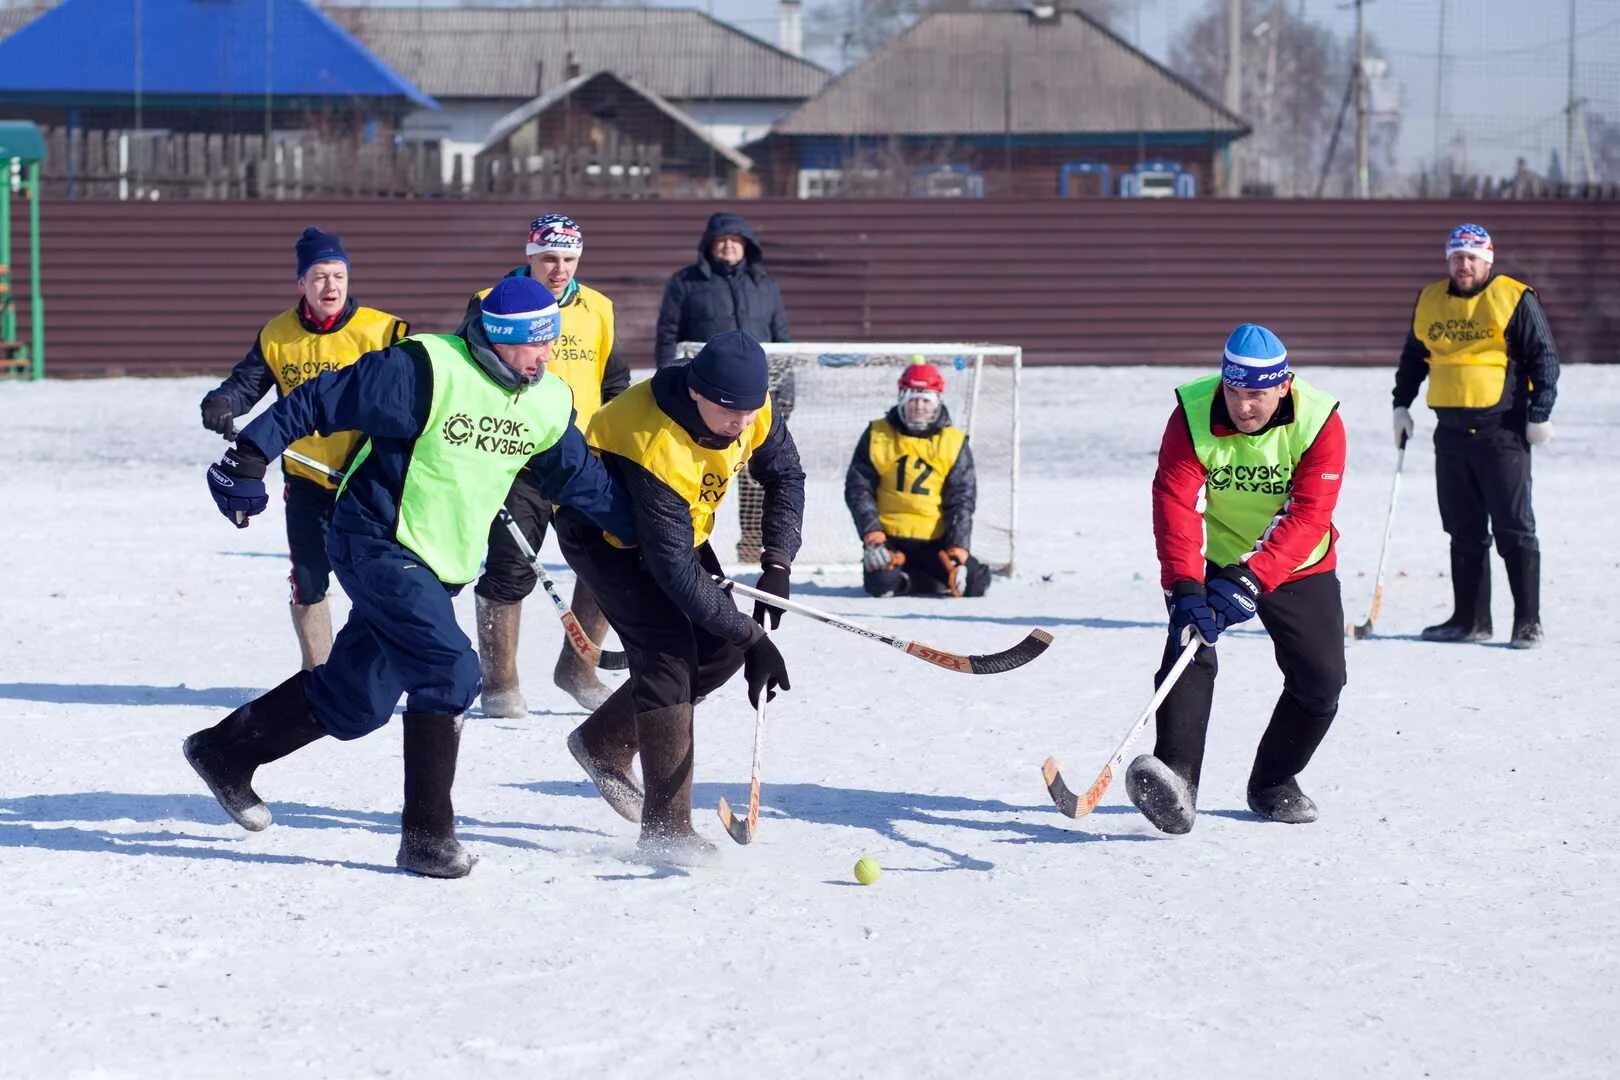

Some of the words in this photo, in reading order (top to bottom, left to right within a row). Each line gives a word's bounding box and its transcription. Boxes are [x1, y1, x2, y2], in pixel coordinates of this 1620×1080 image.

[479, 416, 529, 438] СУЭК-
[896, 454, 933, 496] 12
[1235, 463, 1290, 480] СУЭК-
[1240, 575, 1259, 595] STEX
[566, 621, 593, 657] STEX
[919, 649, 966, 671] STEX
